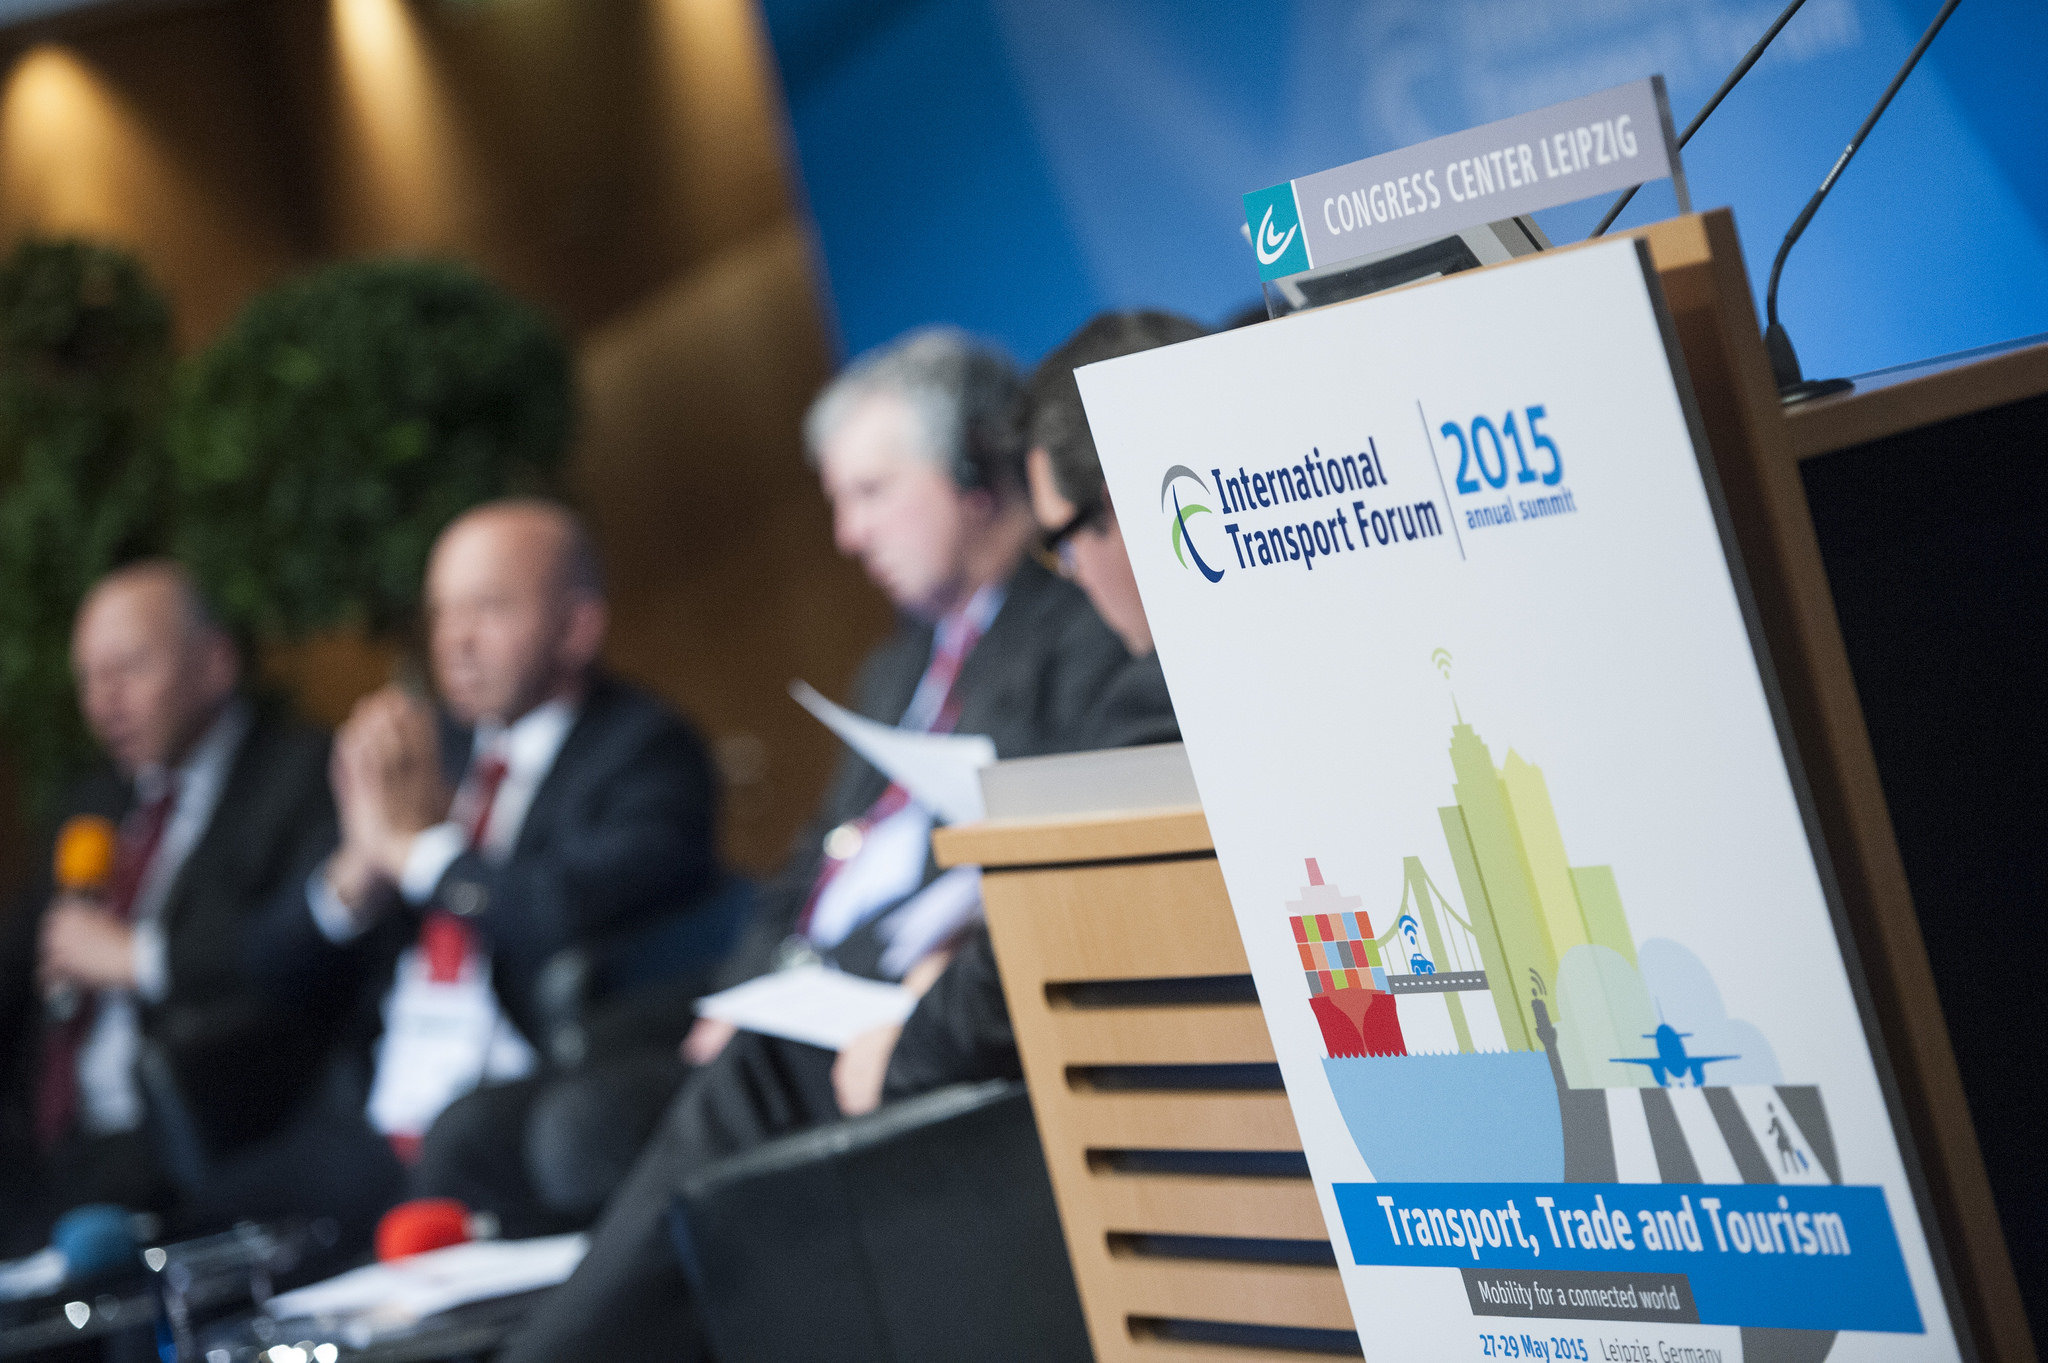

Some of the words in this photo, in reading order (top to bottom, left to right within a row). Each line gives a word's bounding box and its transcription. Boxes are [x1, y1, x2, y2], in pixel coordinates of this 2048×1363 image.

[1323, 169, 1441, 235] CONGRESS
[1446, 143, 1538, 203] CENTER
[1540, 115, 1638, 178] LEIPZIG
[1212, 436, 1388, 514] International
[1440, 404, 1564, 495] 2015
[1225, 507, 1355, 571] Transport
[1353, 499, 1443, 548] Forum
[1465, 496, 1516, 530] annual
[1520, 487, 1577, 520] summit
[1377, 1195, 1539, 1260] Transport,
[1537, 1194, 1635, 1251] Trade
[1638, 1194, 1702, 1252] and
[1702, 1195, 1852, 1256] Tourism
[1478, 1281, 1533, 1310] Mobility
[1533, 1281, 1554, 1306] for
[1558, 1288, 1567, 1306] a
[1568, 1284, 1638, 1309] connected
[1639, 1285, 1681, 1311] world
[1479, 1334, 1520, 1359] 27-29
[1520, 1334, 1550, 1363] May
[1550, 1337, 1588, 1361] 2015
[1599, 1338, 1658, 1363] Leipzig,
[1658, 1340, 1723, 1363] Germany
